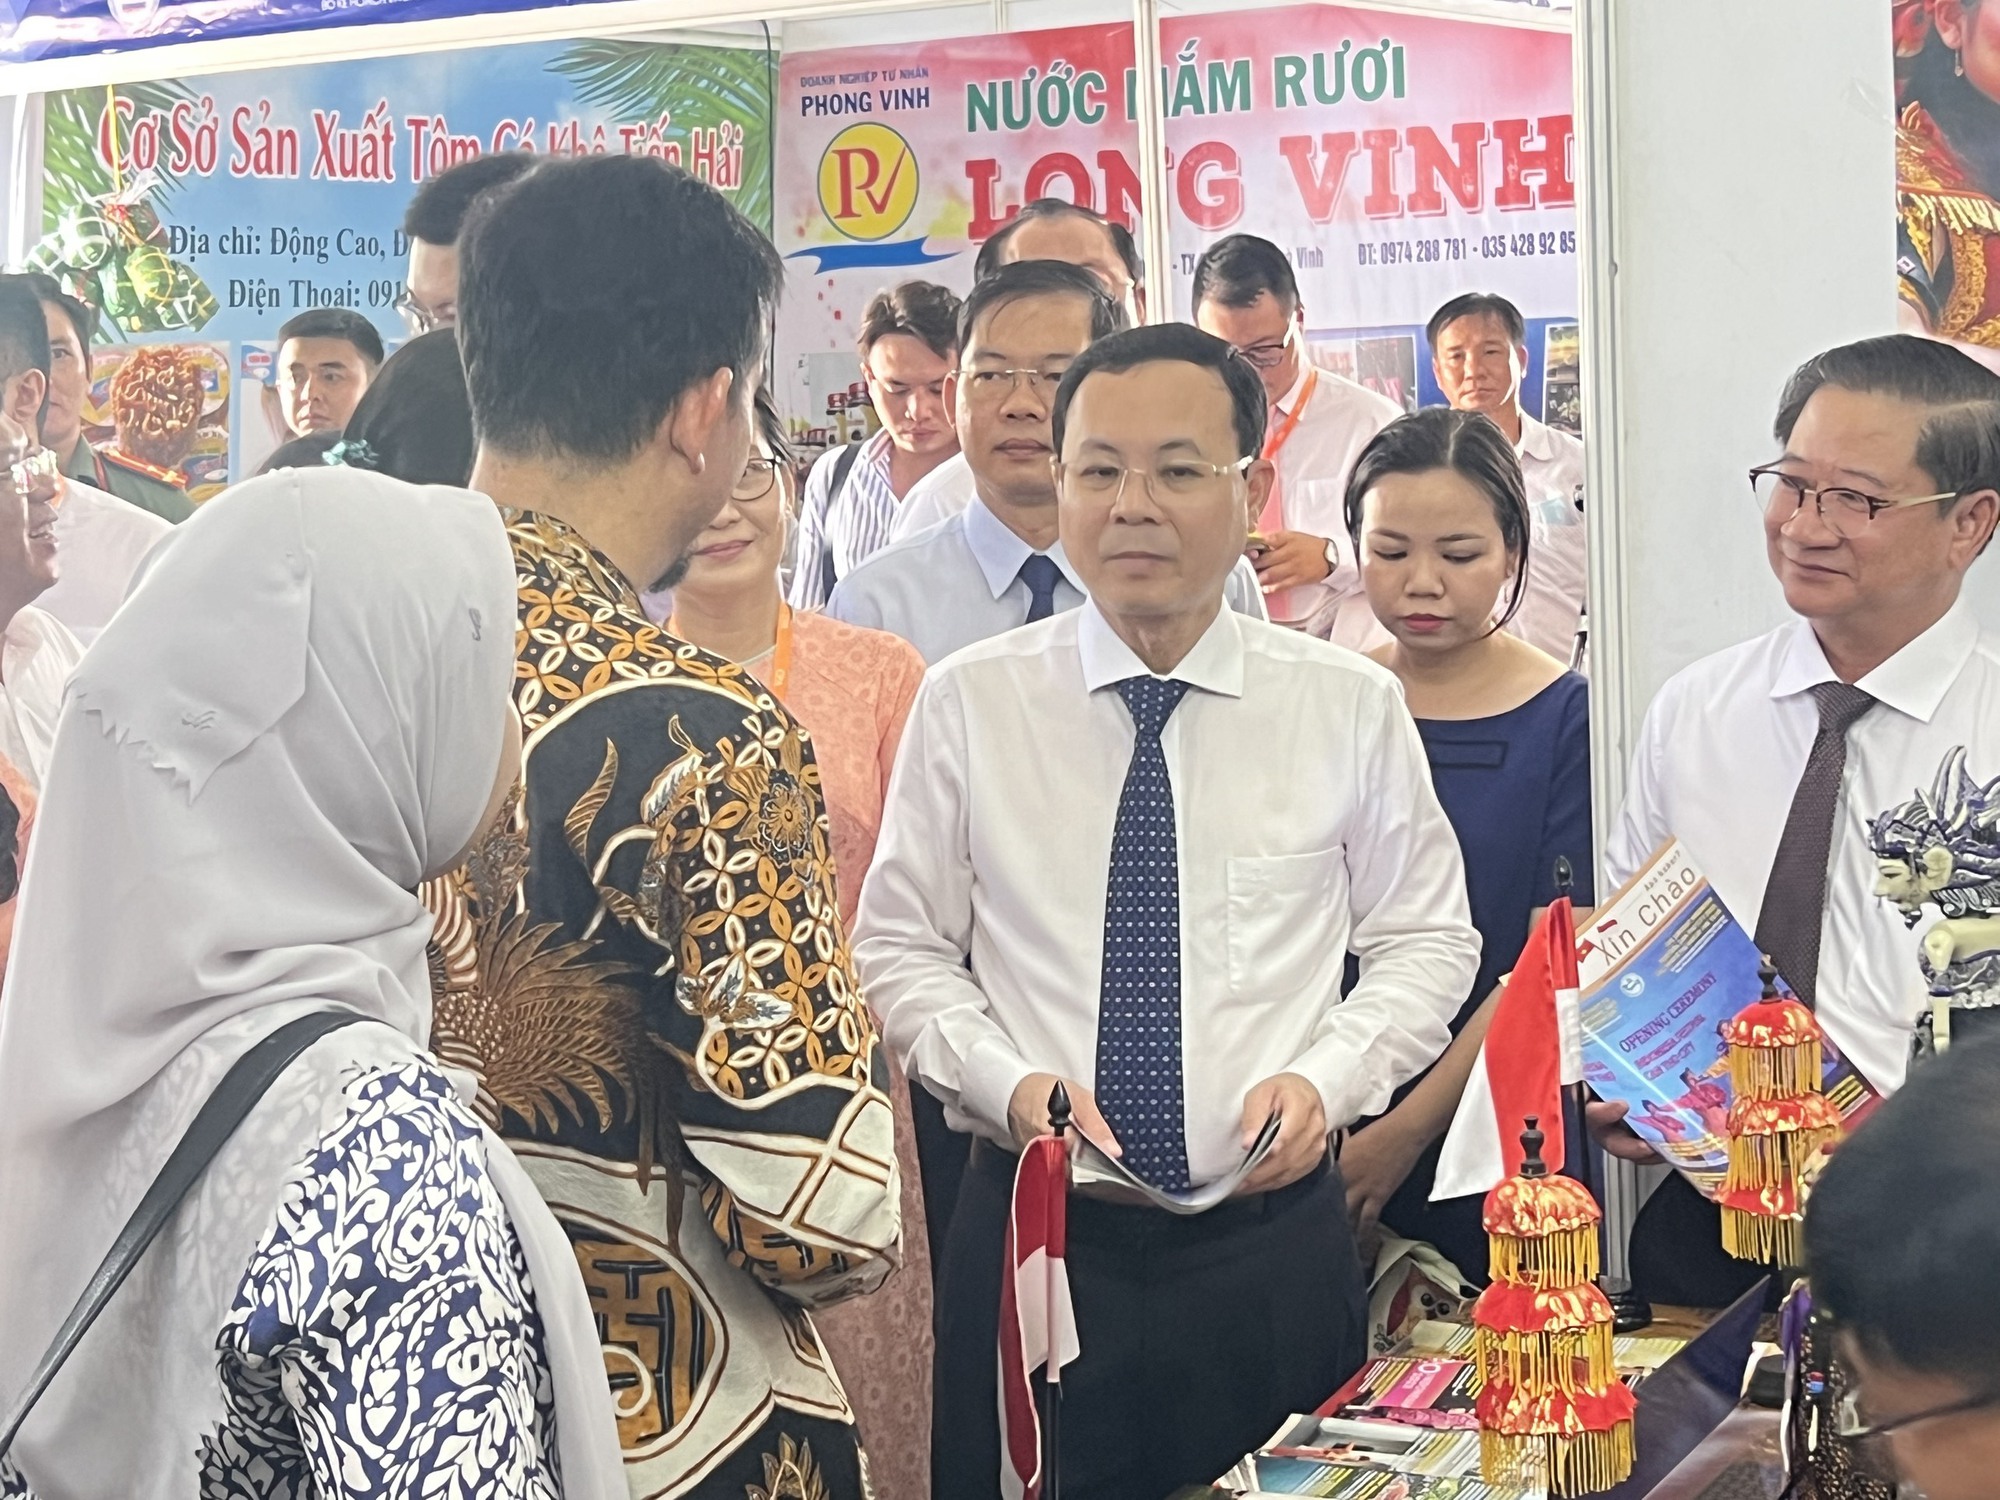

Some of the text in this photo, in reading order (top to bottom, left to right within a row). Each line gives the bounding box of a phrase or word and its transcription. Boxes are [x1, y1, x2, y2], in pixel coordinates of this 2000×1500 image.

[801, 87, 930, 117] PHONG VINH
[967, 60, 1106, 132] NƯỚC
[1274, 38, 1405, 108] RƯƠI
[99, 99, 161, 172] Cơ
[168, 96, 220, 176] Sở
[229, 98, 299, 178] Sản
[311, 98, 396, 180] Xuất
[690, 119, 744, 189] Hải
[1279, 114, 1575, 223] VINH
[168, 225, 210, 263] Địa
[217, 225, 261, 256] chỉ:
[269, 226, 329, 265] Động
[335, 228, 386, 262] Cao,
[1296, 246, 1324, 269] Vinh
[1380, 240, 1413, 265] 0974
[1416, 239, 1440, 263] 288
[1444, 237, 1467, 261] 781
[1481, 234, 1507, 259] 035
[1510, 232, 1536, 257] 428
[1538, 231, 1556, 255] 92
[1559, 230, 1576, 254] 85
[229, 278, 280, 315] Điện
[1592, 928, 1637, 967] Xin
[1619, 1012, 1671, 1053] OPENING
